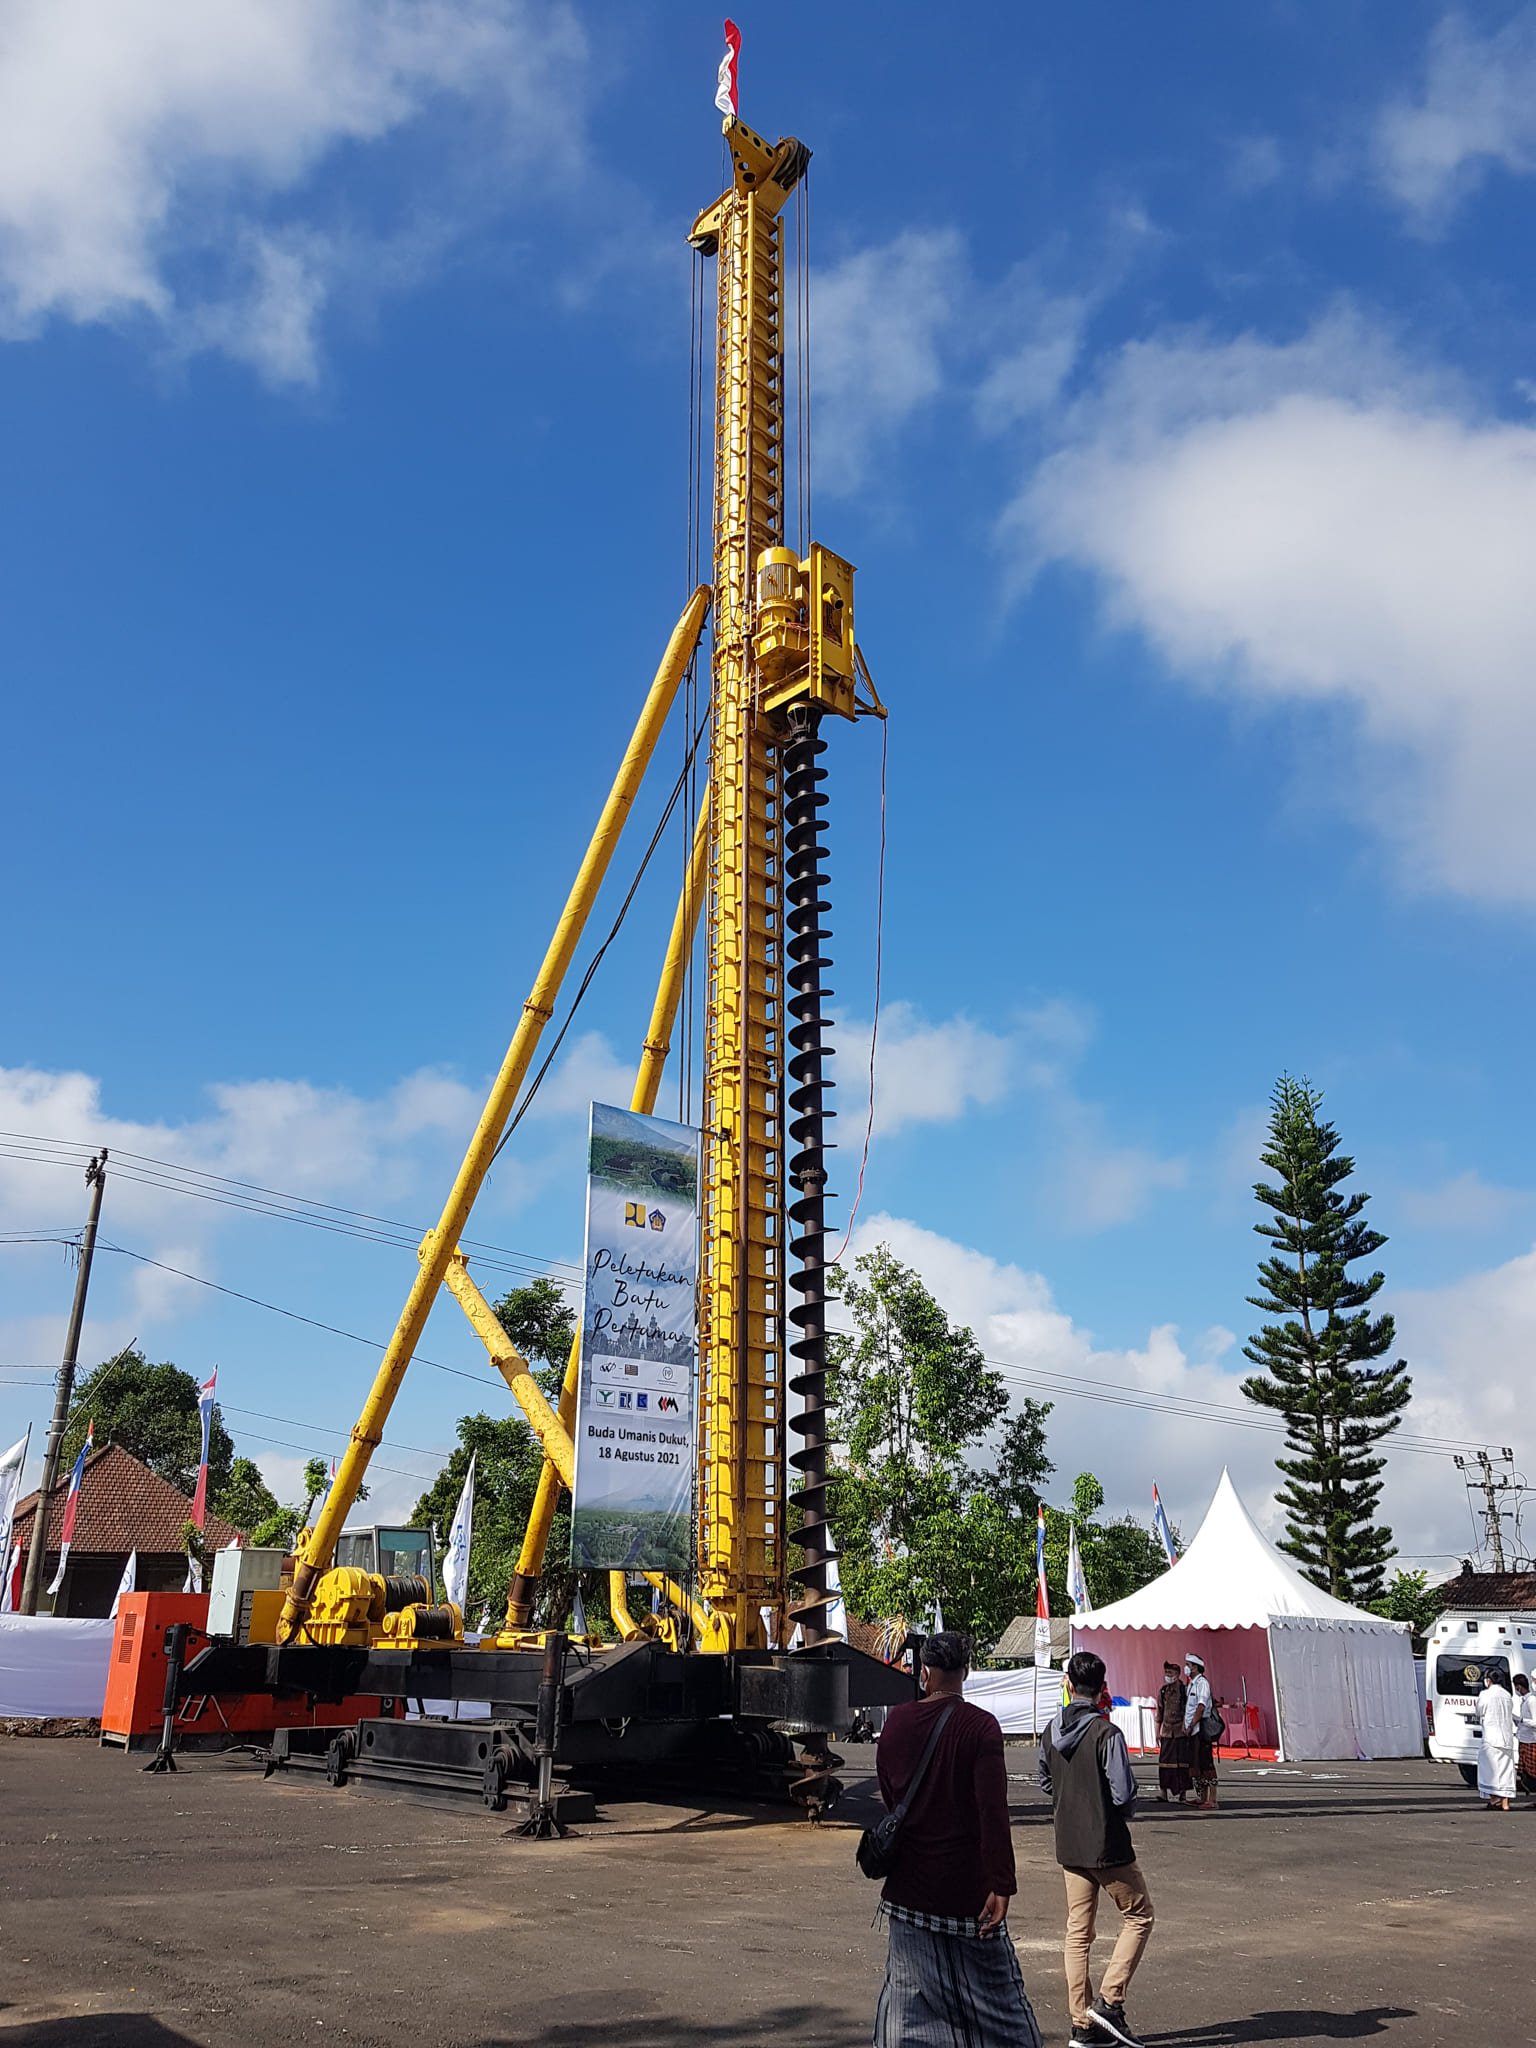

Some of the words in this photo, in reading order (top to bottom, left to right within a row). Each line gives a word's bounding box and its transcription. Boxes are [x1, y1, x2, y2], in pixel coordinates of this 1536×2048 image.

[592, 1248, 694, 1287] Peletakan
[611, 1278, 671, 1312] Batu
[591, 1307, 683, 1342] Pertama
[588, 1425, 615, 1439] Buda
[618, 1428, 656, 1443] Umanis
[659, 1432, 689, 1448] Dukut,
[598, 1446, 612, 1459] 18
[614, 1448, 655, 1462] Agustus
[657, 1451, 680, 1465] 2021
